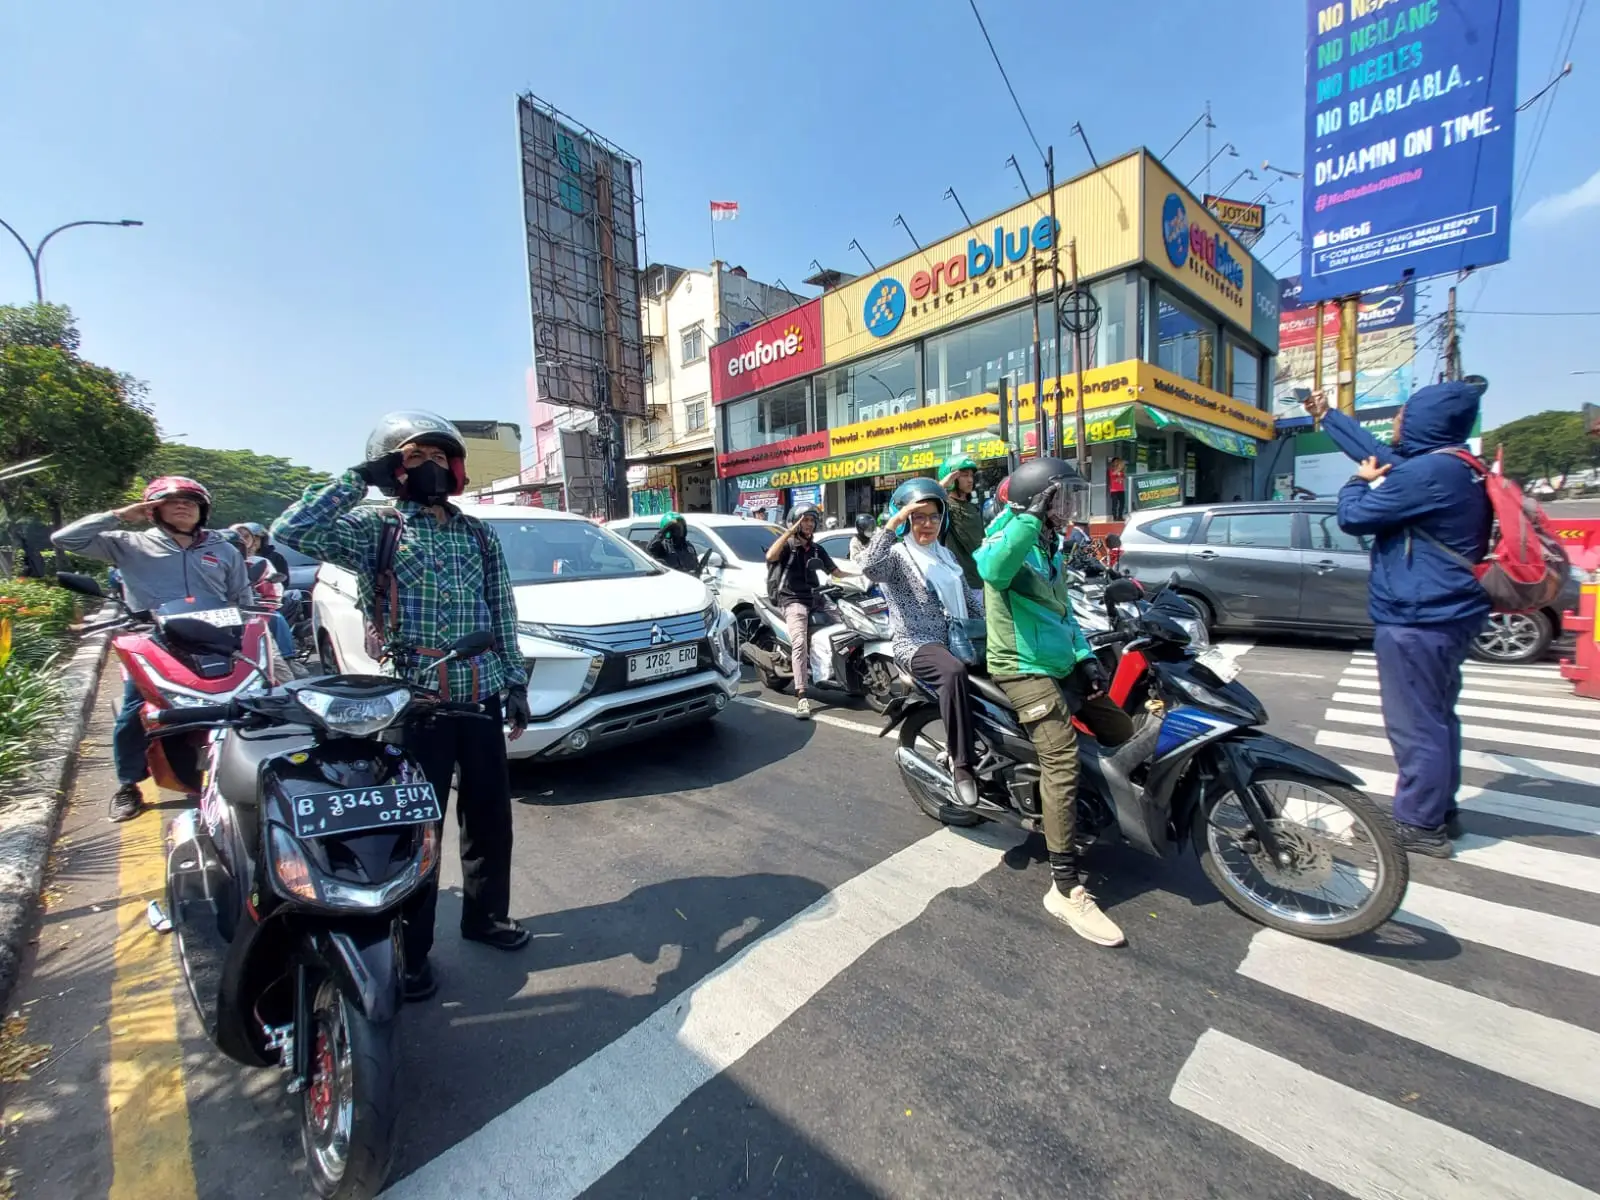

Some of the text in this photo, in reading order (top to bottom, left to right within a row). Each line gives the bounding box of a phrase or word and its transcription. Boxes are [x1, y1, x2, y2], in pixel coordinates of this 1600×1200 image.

[1317, 1, 1439, 69] NO NGILANG
[1318, 2, 1344, 36] NO
[1316, 41, 1423, 104] NO NGELES
[1316, 107, 1342, 138] NO
[1315, 106, 1501, 186] DIJAMIN ON TIME.
[1221, 205, 1260, 224] JOTUN
[1329, 221, 1371, 243] blibli
[909, 215, 1061, 300] erablue
[1319, 239, 1385, 262] E-COMMERCE
[1386, 232, 1414, 247] YANG
[1443, 215, 1481, 231] REPOT
[1328, 256, 1349, 268] DAN
[1407, 228, 1468, 248] INDONESIA
[911, 257, 1060, 318] ELECTRONIC
[728, 333, 799, 377] erafone
[866, 425, 895, 439] Kulkas
[899, 419, 927, 432] Mesin
[927, 412, 949, 426] cuci
[954, 409, 970, 421] AC
[1080, 376, 1130, 395] angga
[769, 470, 819, 488] GRATIS
[821, 454, 881, 479] UMROH
[630, 658, 637, 673] B
[645, 652, 671, 669] 1782
[297, 798, 315, 817] B
[328, 789, 385, 812] 3346
